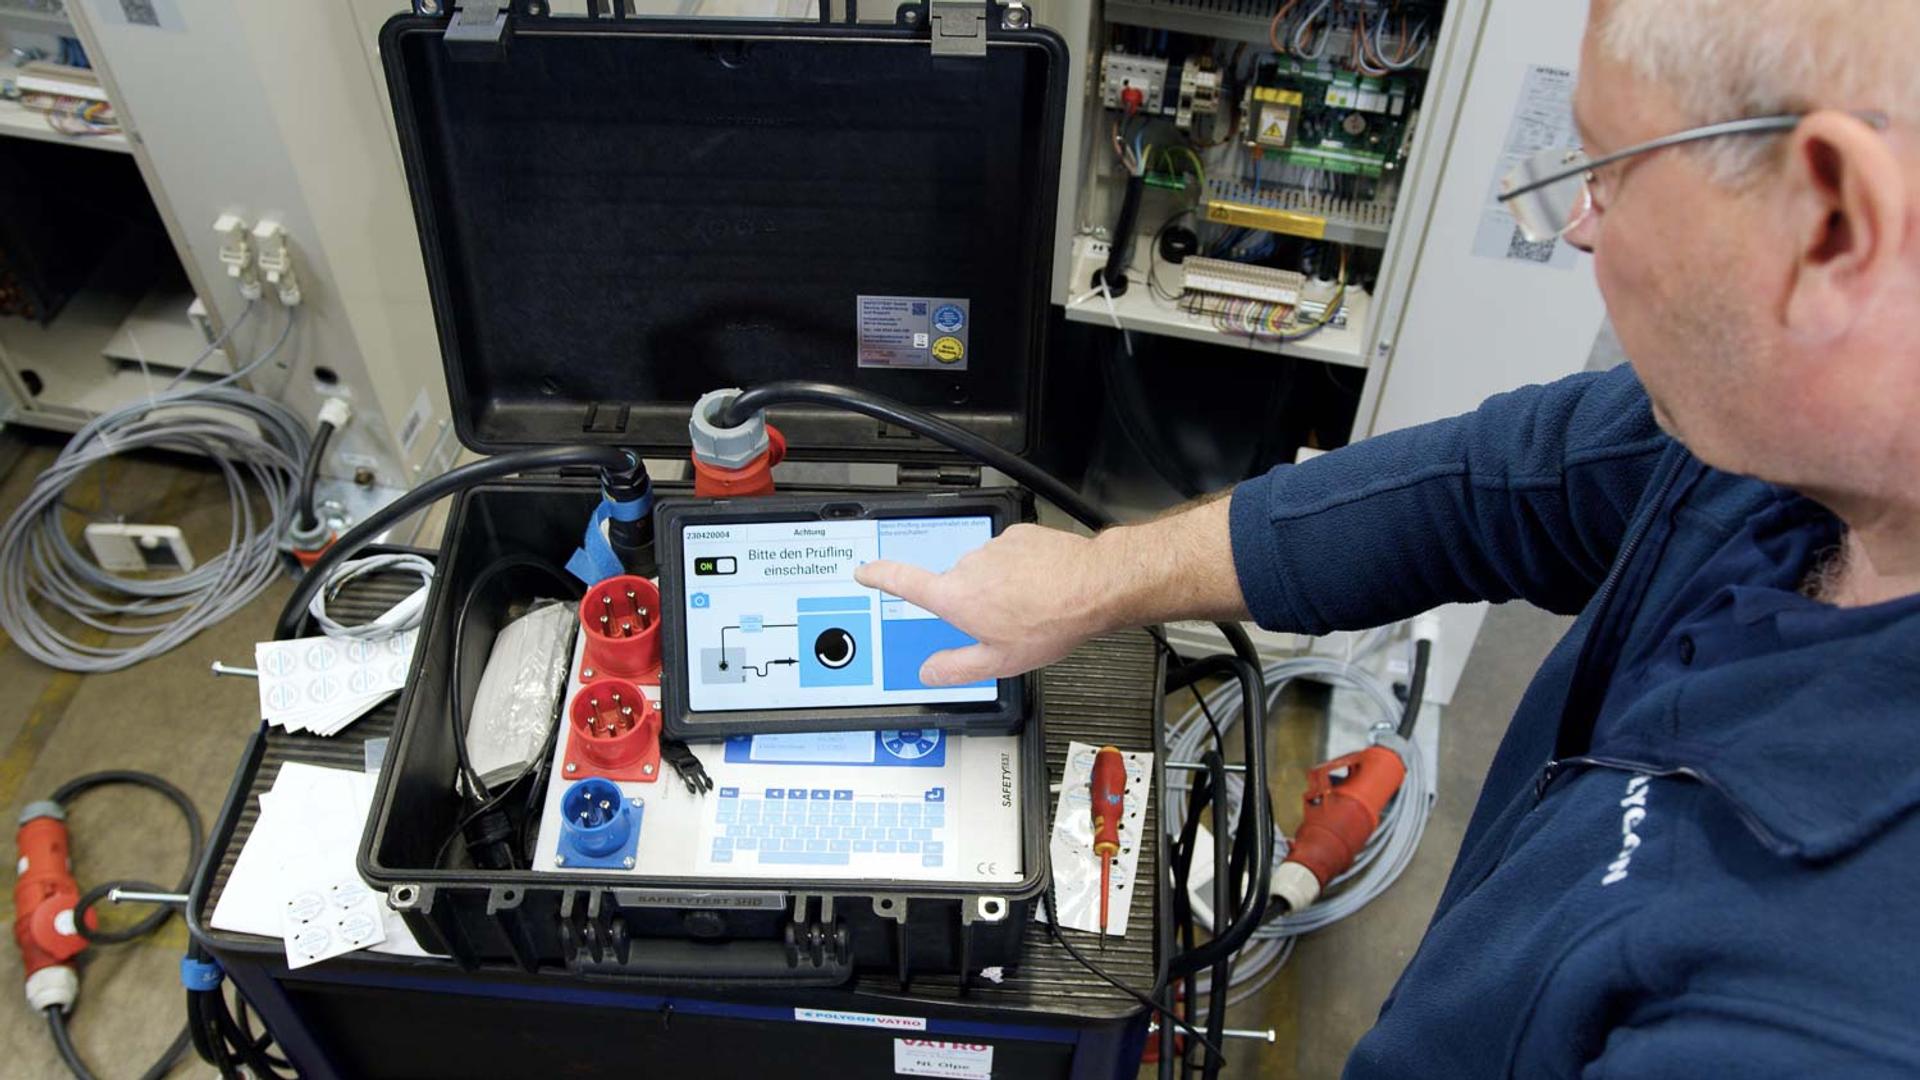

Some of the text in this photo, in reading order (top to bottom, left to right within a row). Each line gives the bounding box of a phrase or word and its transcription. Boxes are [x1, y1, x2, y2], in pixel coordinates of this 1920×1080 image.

[686, 531, 730, 540] 230420004
[793, 528, 826, 537] Achtung
[749, 546, 853, 561] Bitte den Prüfling
[700, 562, 713, 571] ON
[764, 563, 838, 576] einschalten!
